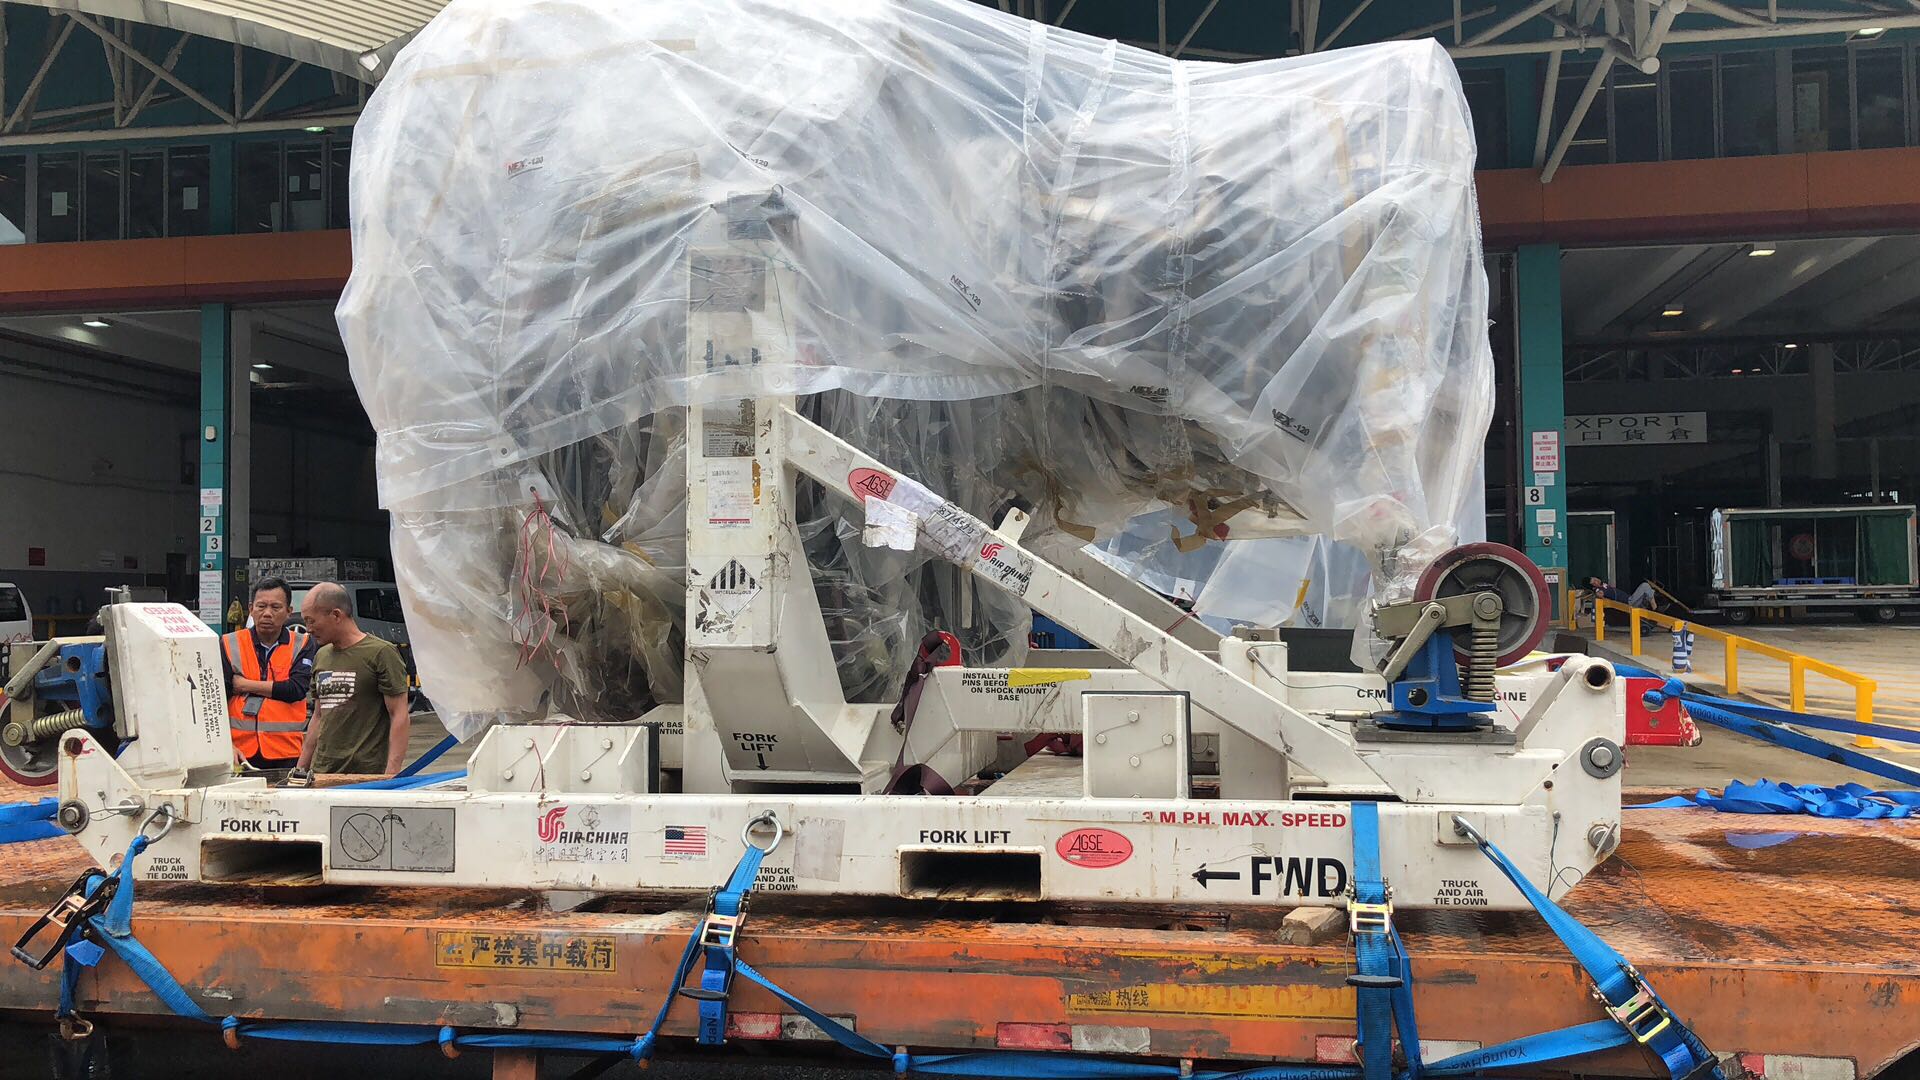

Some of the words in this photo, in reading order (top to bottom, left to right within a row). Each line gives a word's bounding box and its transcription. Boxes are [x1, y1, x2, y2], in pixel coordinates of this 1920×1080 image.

[1564, 415, 1685, 429] XPORT
[1530, 489, 1539, 502] 8
[204, 519, 212, 531] 2
[210, 538, 219, 549] 3
[210, 681, 218, 714] CASTER
[1357, 689, 1386, 699] CFM
[1494, 692, 1527, 701] GINE
[732, 733, 778, 742] FORK
[740, 743, 775, 752] LIFT
[220, 820, 262, 832] FORK
[268, 820, 300, 833] LIFT
[1281, 813, 1347, 828] SPEED
[584, 831, 629, 845] CHINA
[919, 830, 967, 844] FORK
[974, 830, 1011, 844] LIFT
[1067, 834, 1104, 853] AGSE
[161, 872, 189, 880] DOWN
[778, 875, 795, 883] AIR
[1251, 856, 1347, 897] FWD
[752, 883, 765, 891] TIE
[768, 883, 798, 891] DOWN
[1441, 880, 1478, 888] TRUCK
[1465, 889, 1484, 897] AIR
[1433, 897, 1450, 905] TIE
[469, 936, 612, 969] 严禁集中载荷
